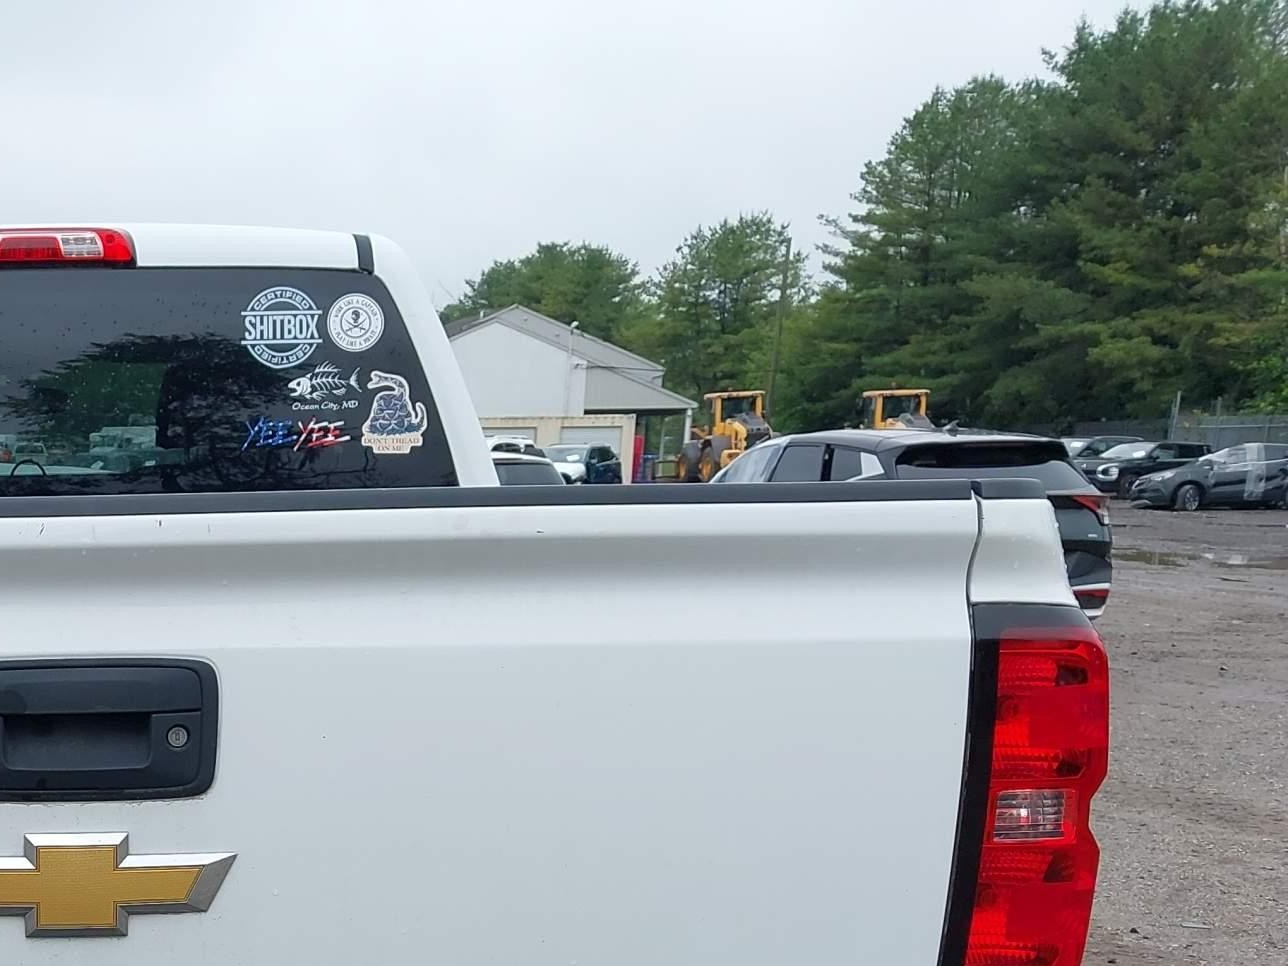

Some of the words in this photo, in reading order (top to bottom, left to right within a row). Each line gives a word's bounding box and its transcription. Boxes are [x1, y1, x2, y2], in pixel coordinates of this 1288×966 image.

[253, 290, 310, 310] CERTIFIED
[244, 314, 320, 340] SHITBOX
[253, 343, 311, 365] CERTIFIED
[292, 401, 320, 410] Ocean
[342, 399, 359, 410] MD
[241, 415, 297, 451] YEE
[293, 416, 352, 452] YEE
